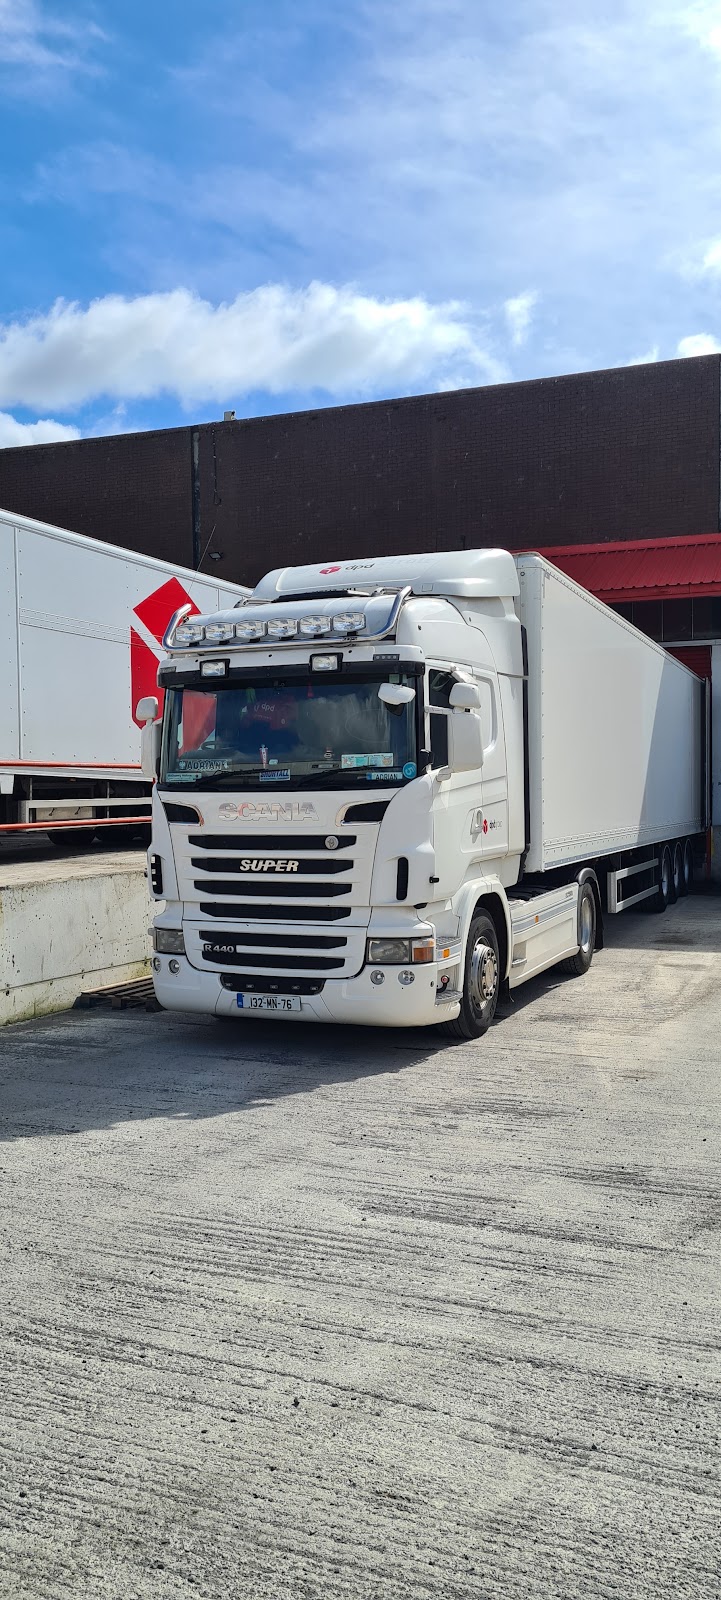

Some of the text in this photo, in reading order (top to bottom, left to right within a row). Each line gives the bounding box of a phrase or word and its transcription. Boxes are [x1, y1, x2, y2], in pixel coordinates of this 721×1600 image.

[345, 563, 375, 571] dpd
[186, 760, 221, 770] ADRIAN
[218, 803, 320, 821] SCANIA
[240, 859, 299, 872] SUPER
[250, 997, 292, 1010] 132-MN-76
